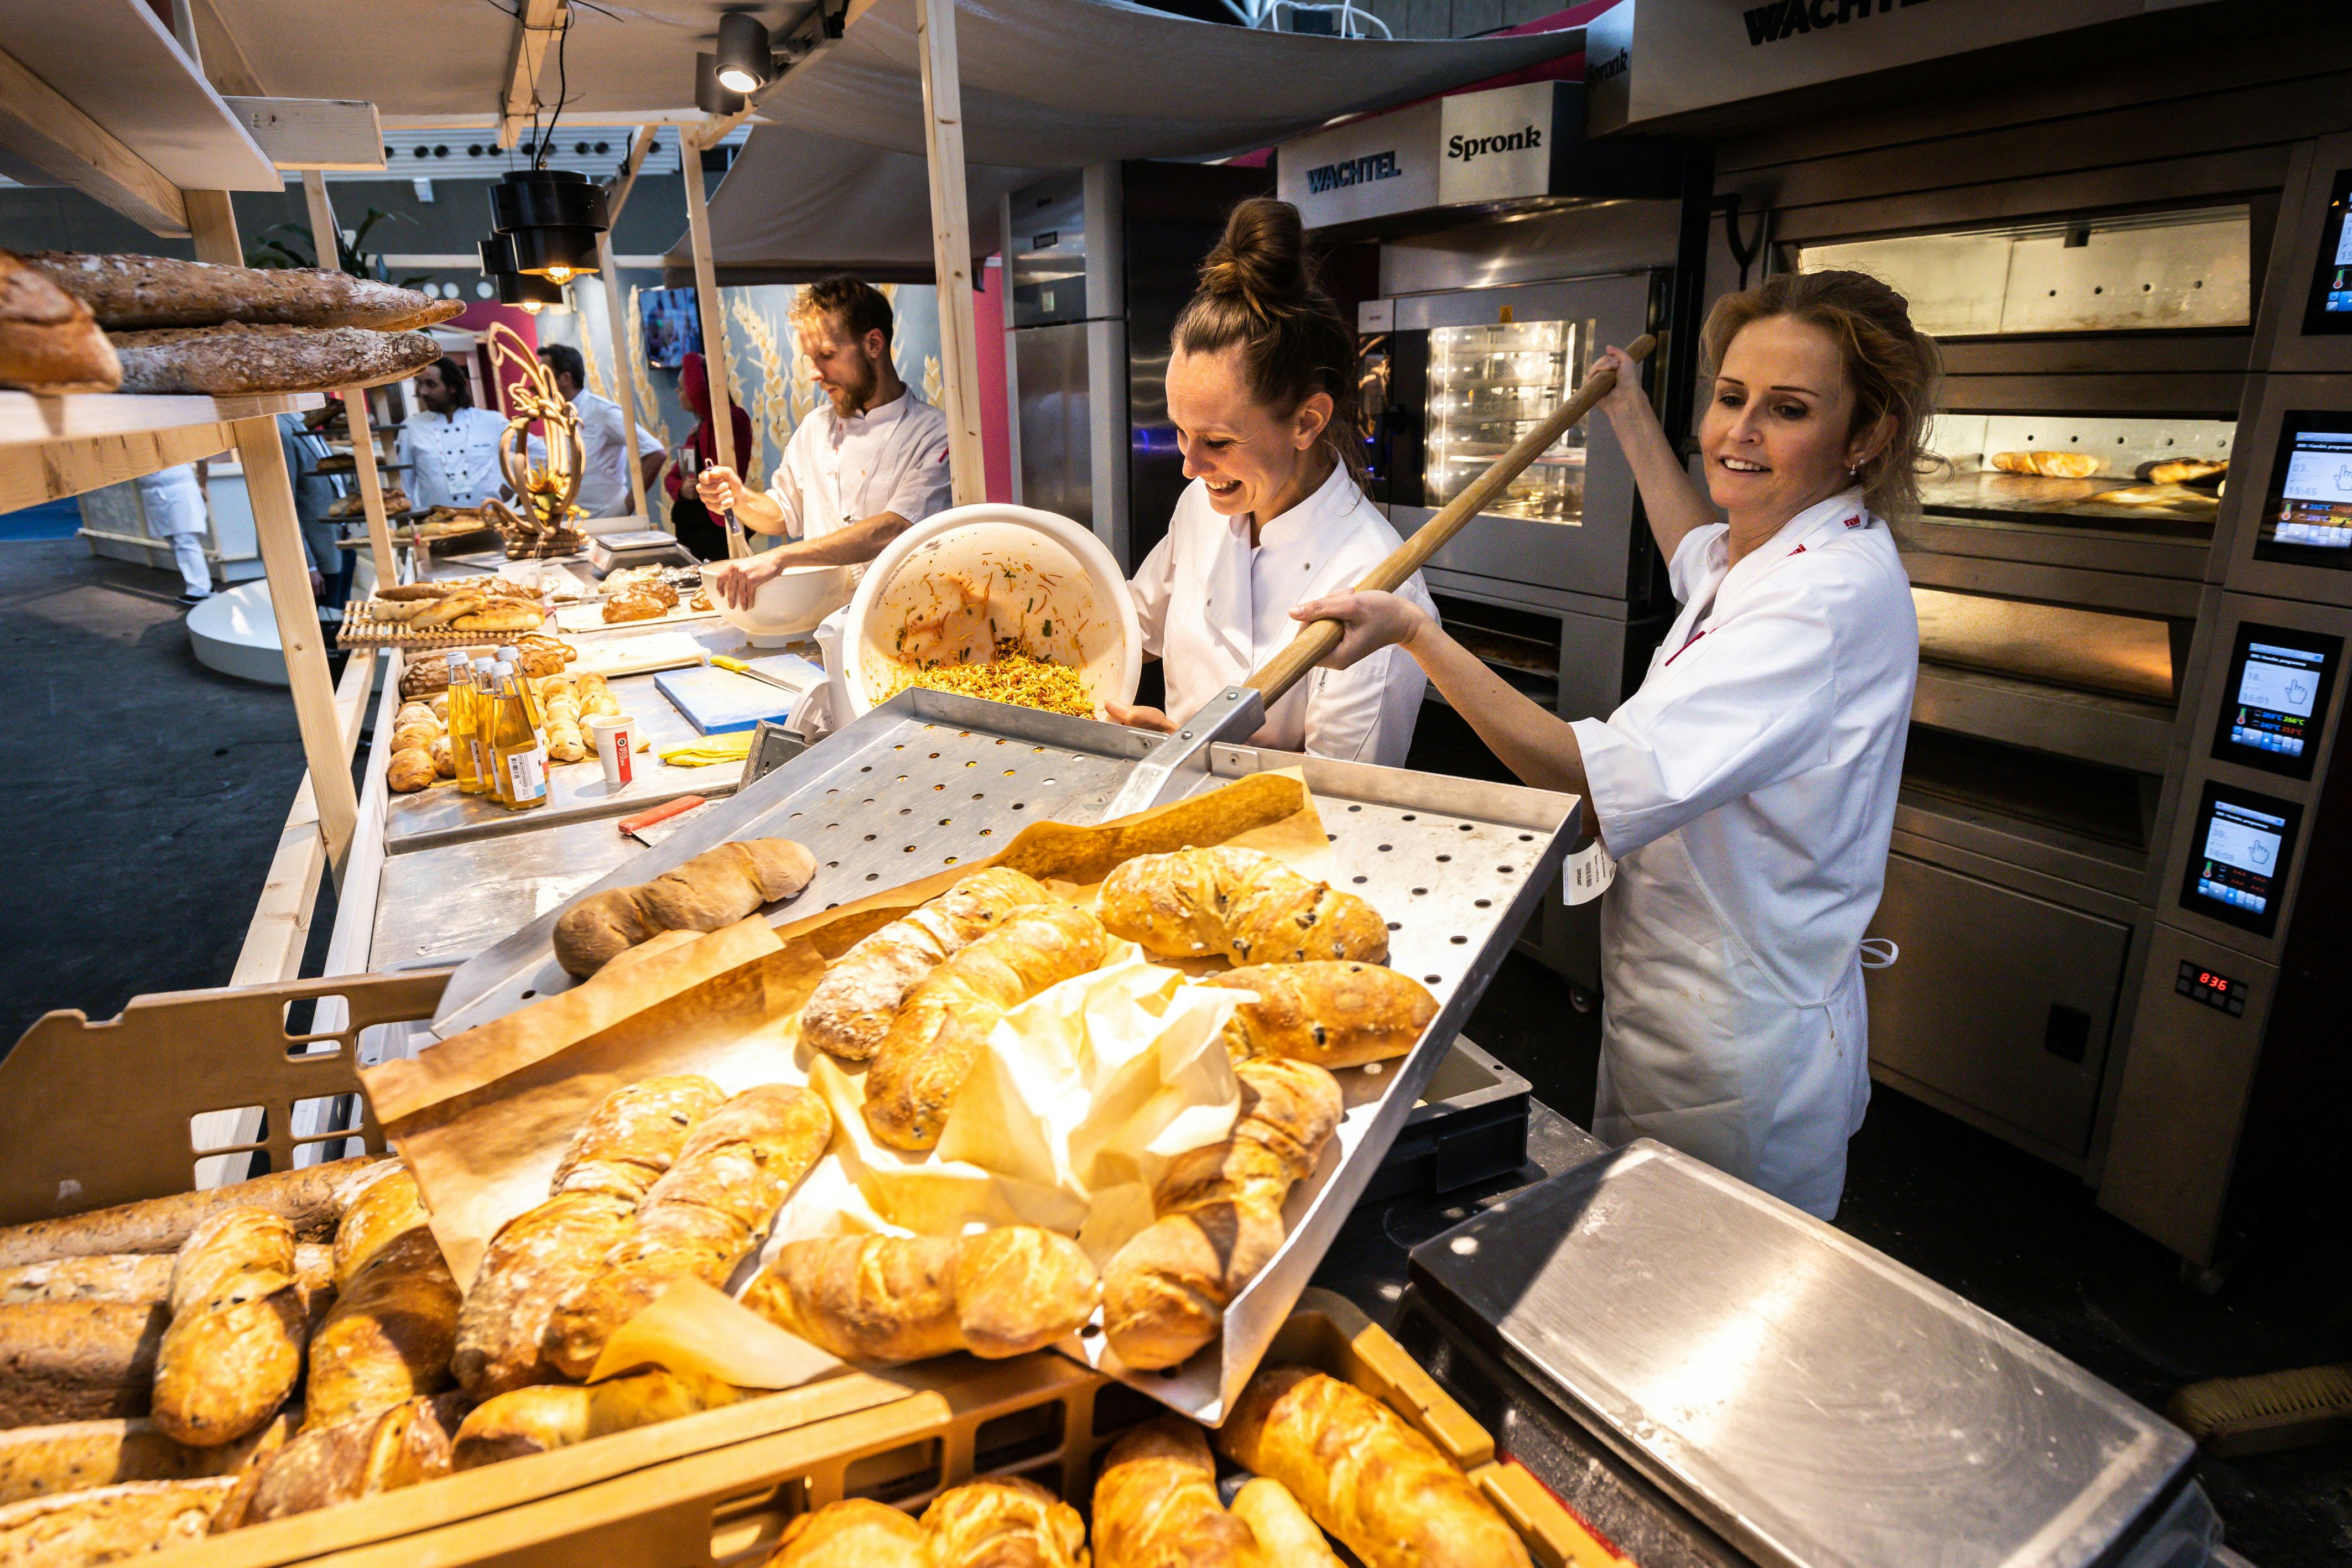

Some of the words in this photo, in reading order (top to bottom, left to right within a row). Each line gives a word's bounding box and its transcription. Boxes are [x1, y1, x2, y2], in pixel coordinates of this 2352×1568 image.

[1744, 0, 1934, 46] WACH
[1586, 46, 1627, 90] Spronk
[1448, 124, 1542, 162] Spronk
[1307, 150, 1402, 193] WACHTEL
[2289, 486, 2317, 496] 15:45
[2247, 672, 2260, 681] 18
[2243, 693, 2269, 705] 16:01
[2199, 972, 2228, 991] 836
